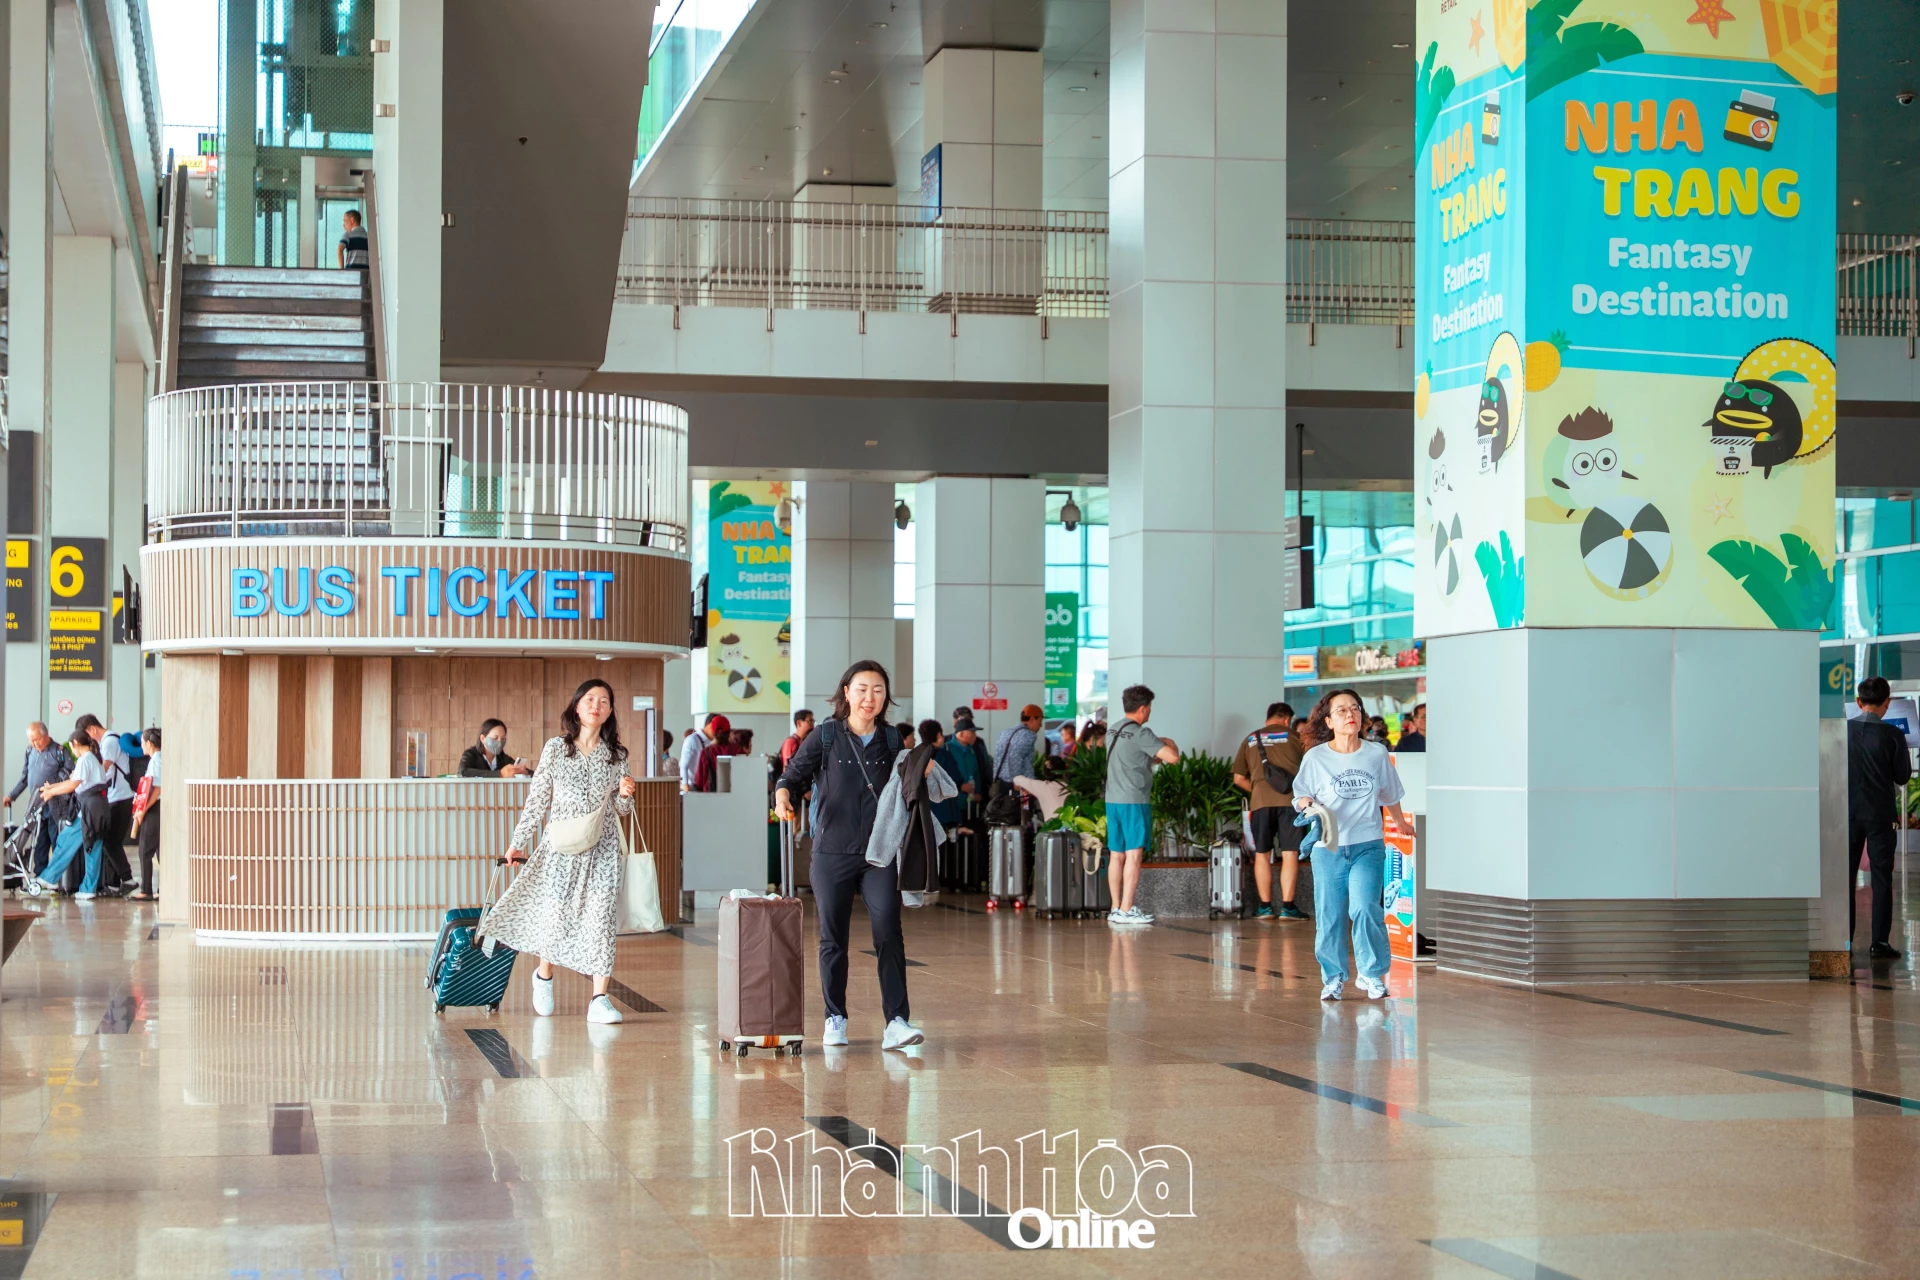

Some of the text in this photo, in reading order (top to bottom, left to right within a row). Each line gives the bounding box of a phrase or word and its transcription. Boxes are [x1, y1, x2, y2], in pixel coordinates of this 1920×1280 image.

[1440, 0, 1458, 14] RETAIL
[1565, 98, 1704, 154] NHA
[1432, 121, 1475, 191] NHA
[1440, 168, 1507, 243] TRANG
[1593, 165, 1801, 218] TRANG
[1444, 251, 1491, 294] Fantasy
[1609, 237, 1752, 276] Fantasy
[1432, 291, 1504, 343] Destination
[1571, 281, 1789, 319] Destination
[722, 520, 775, 542] NHA
[50, 545, 84, 598] 6
[733, 545, 791, 564] TRAN
[232, 566, 614, 620] BUS TICKET
[724, 587, 792, 600] Destinati
[54, 616, 92, 624] PARKING
[1338, 778, 1368, 788] PARIS
